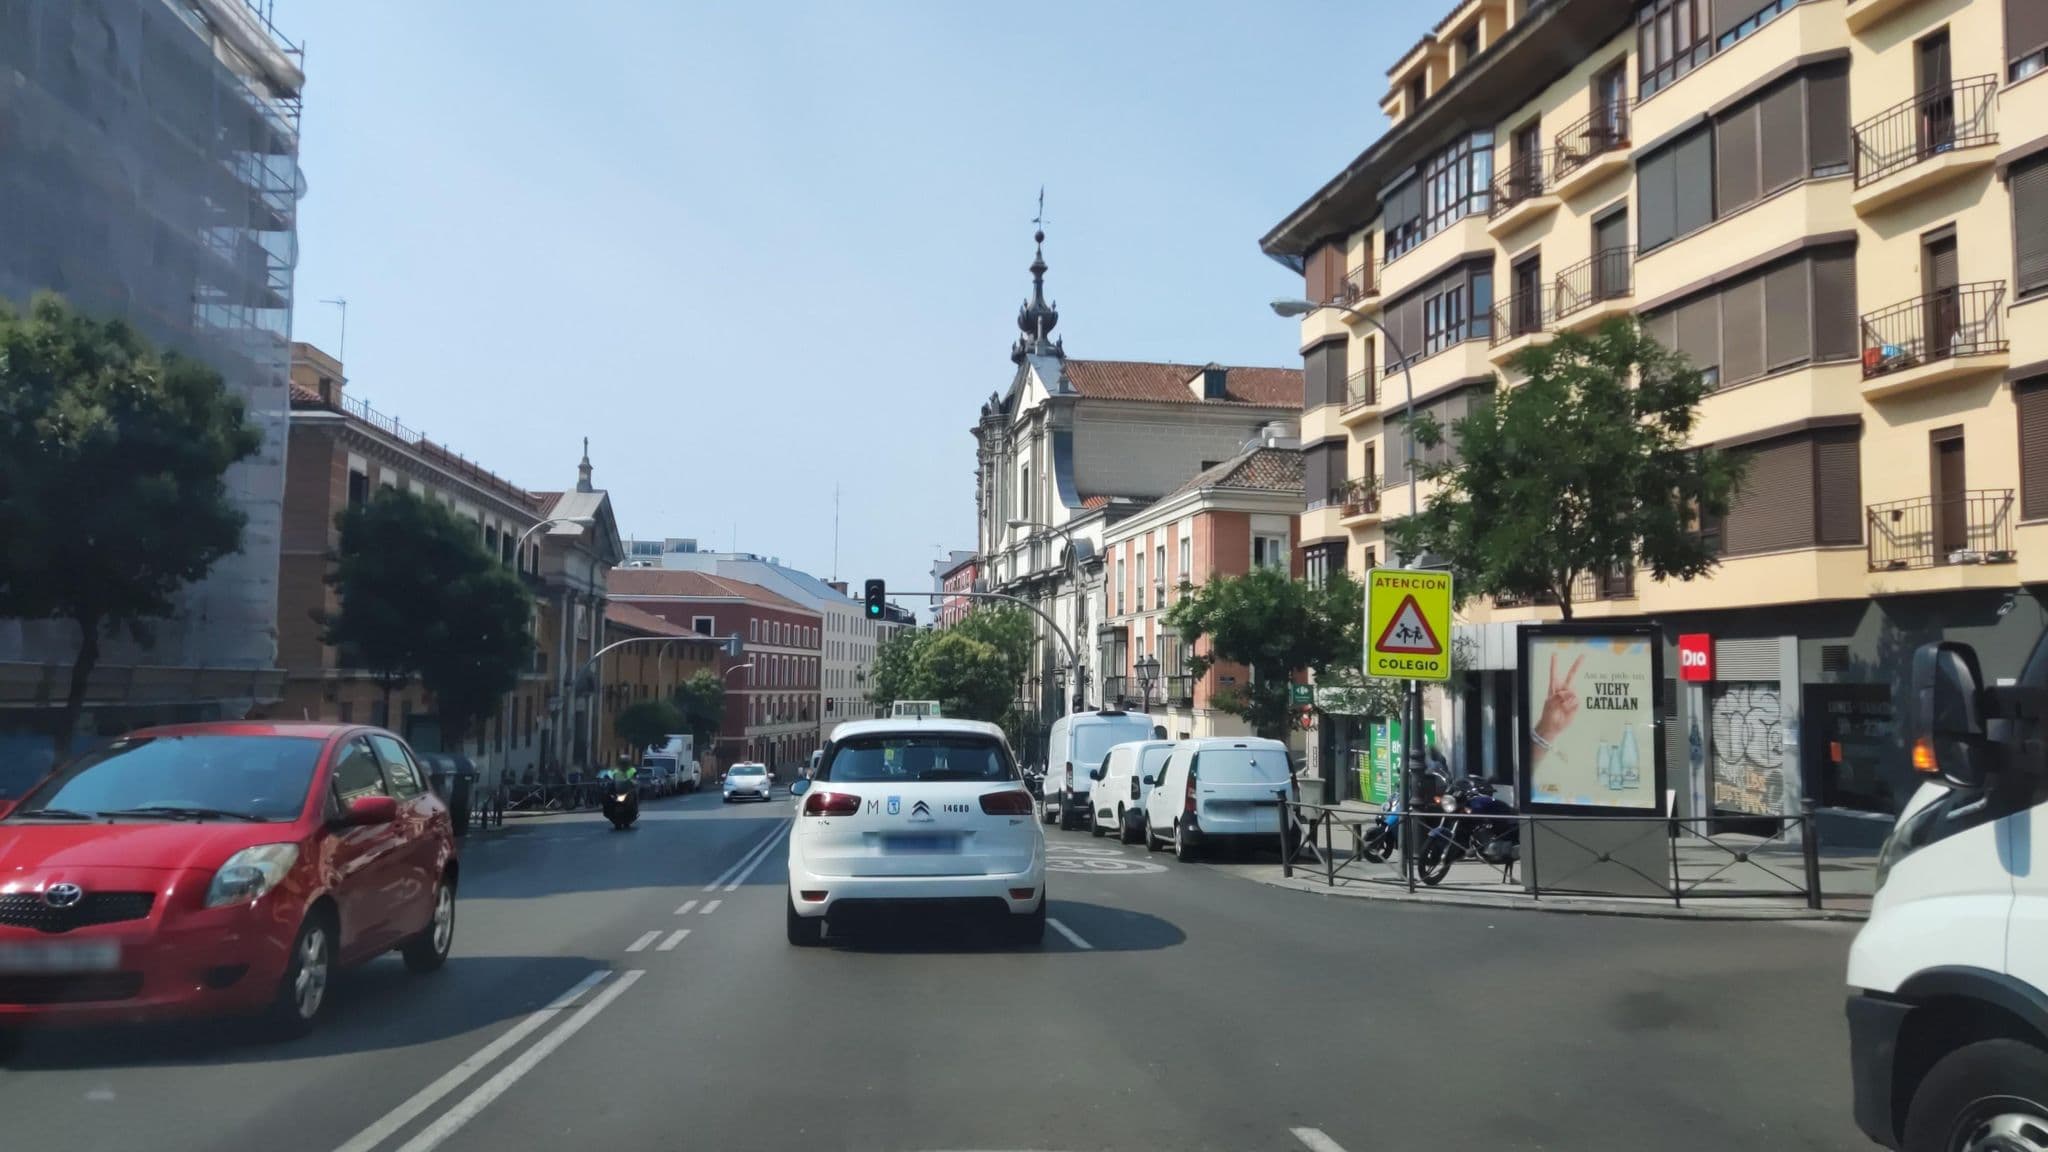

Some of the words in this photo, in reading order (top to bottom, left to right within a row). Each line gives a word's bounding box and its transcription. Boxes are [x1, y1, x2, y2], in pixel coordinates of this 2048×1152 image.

[1375, 577, 1446, 590] ATENCION
[1378, 658, 1439, 671] COLEGIO
[1594, 682, 1630, 696] VICHY
[1586, 696, 1638, 711] CATALAN
[867, 799, 879, 815] M
